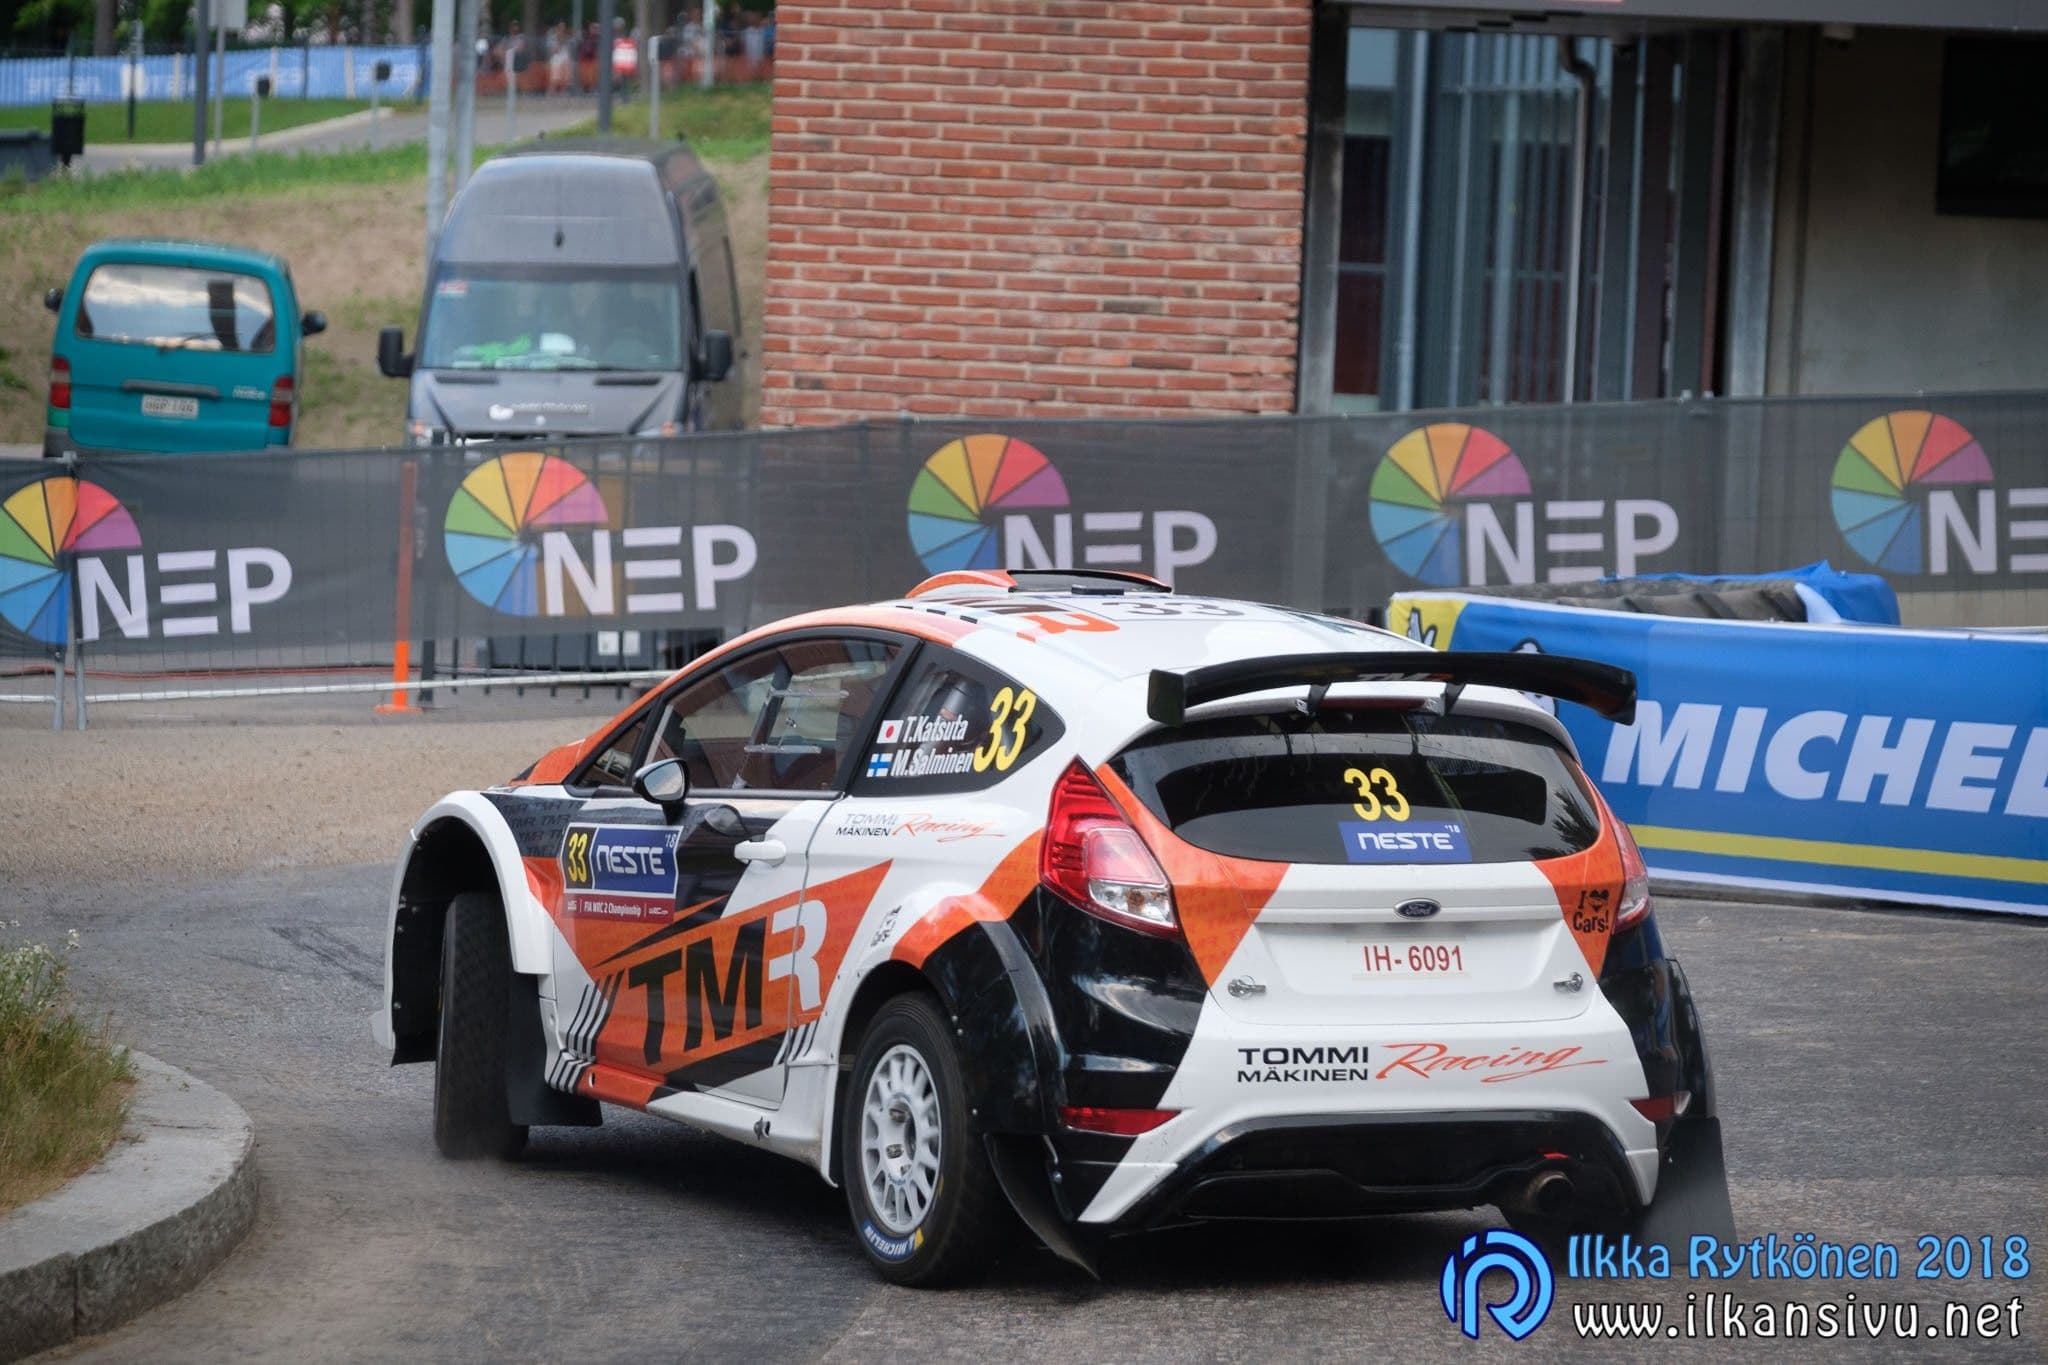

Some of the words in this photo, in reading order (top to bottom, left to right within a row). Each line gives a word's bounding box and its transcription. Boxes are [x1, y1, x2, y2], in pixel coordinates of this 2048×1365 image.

[1004, 510, 1218, 589] NEP
[1465, 499, 1680, 585] NEP
[542, 524, 758, 616] NEP
[77, 547, 292, 641] NEP
[902, 714, 969, 743] T.Katsuta
[973, 686, 1038, 773] 33
[890, 746, 975, 777] M.Salminen
[1344, 767, 1410, 822] 33
[844, 813, 898, 826] TOMMI
[892, 813, 1006, 842] Racing
[1357, 832, 1454, 850] NESTE
[568, 832, 589, 882] 33
[596, 845, 665, 876] NESTE
[608, 903, 642, 918] Championship
[1403, 903, 1433, 916] Ford
[1572, 909, 1610, 934] Cars!
[1408, 945, 1463, 972] 6091
[627, 899, 828, 1066] TMR
[1237, 1046, 1368, 1065] TOMMI
[1375, 1042, 1609, 1083] Racing
[1237, 1067, 1368, 1083] MÄKINEN
